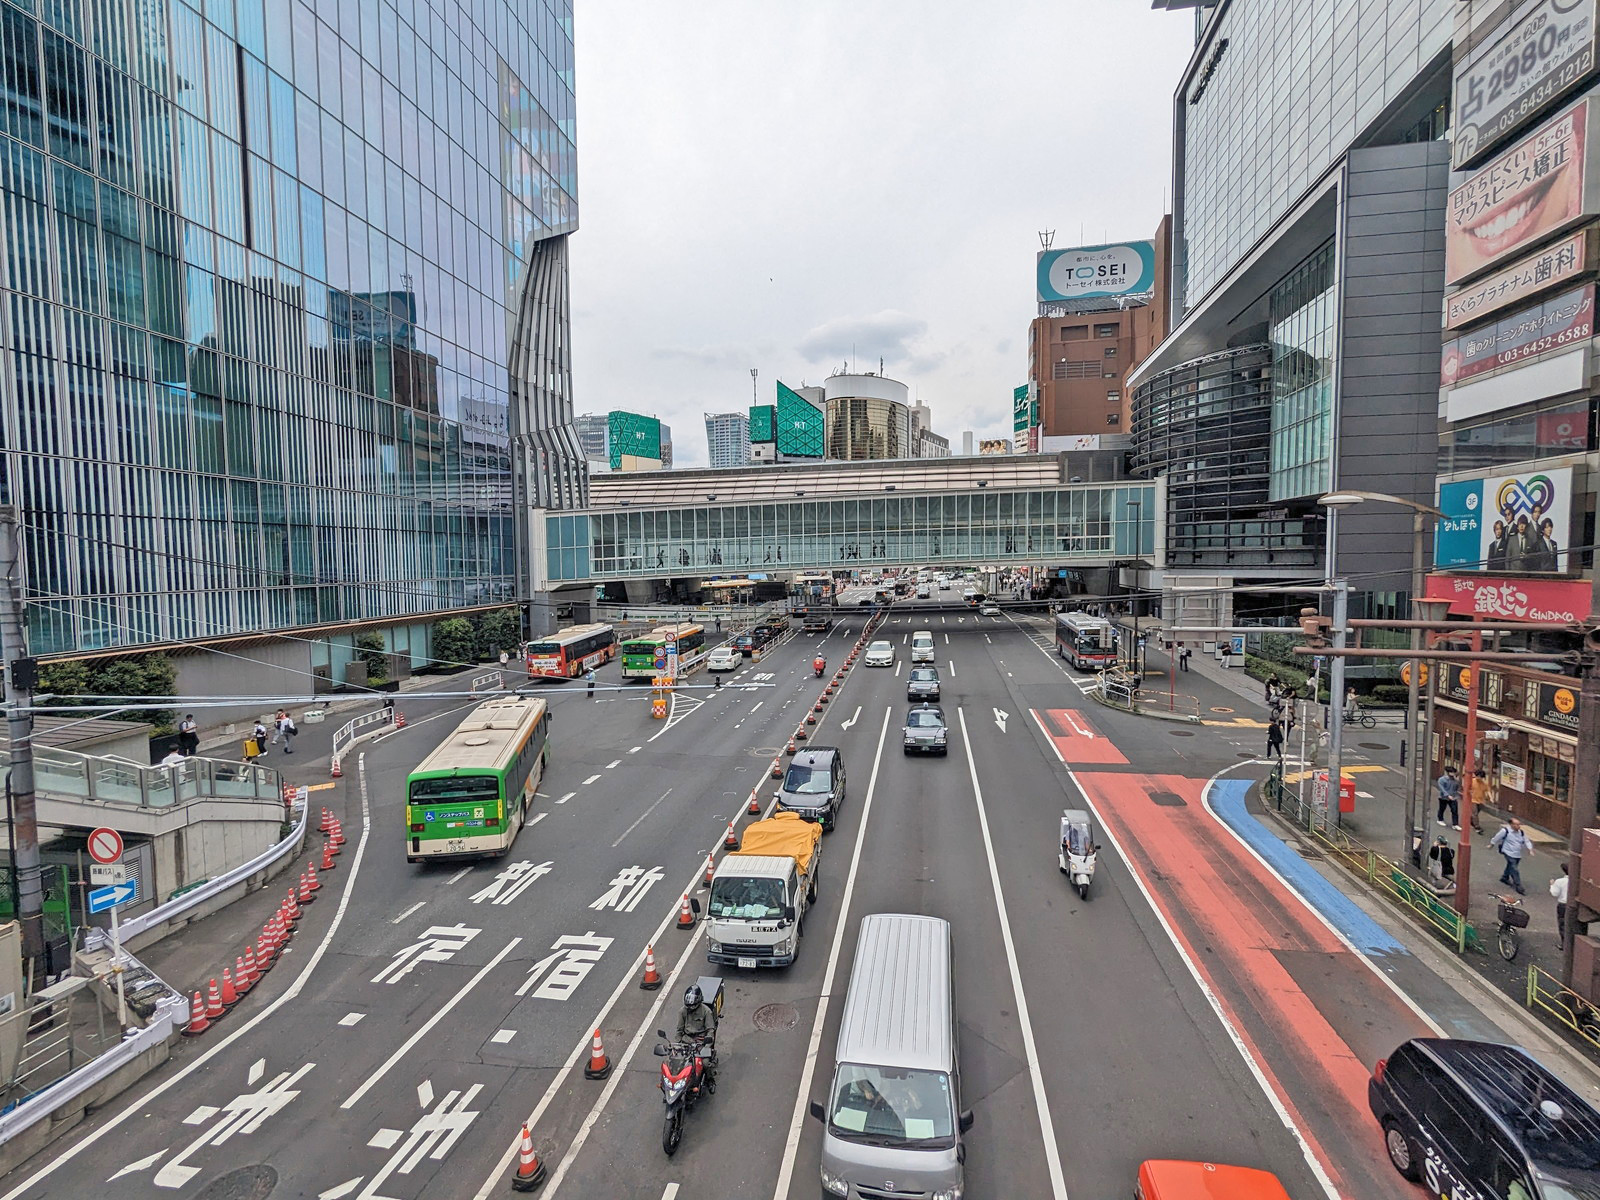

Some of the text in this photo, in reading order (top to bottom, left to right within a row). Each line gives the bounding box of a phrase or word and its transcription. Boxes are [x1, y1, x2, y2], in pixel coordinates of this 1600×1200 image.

[1460, 74, 1486, 126] 占
[1499, 52, 1591, 131] 03-6434-1212
[1458, 135, 1474, 163] 7F
[1453, 150, 1527, 210] 目立ちにくい
[1454, 141, 1571, 226] マウスピース矯正
[1066, 277, 1126, 289] トーセイ株式会社
[1451, 243, 1576, 317] さくらプラチナム歯科
[1466, 298, 1591, 358] 歯のクリーニング・ホワイトニング
[1505, 324, 1590, 362] 03-6452-6588
[1474, 581, 1528, 617] 銀だこ
[1529, 608, 1574, 622] GINDACO
[1548, 710, 1579, 723] GINDACO
